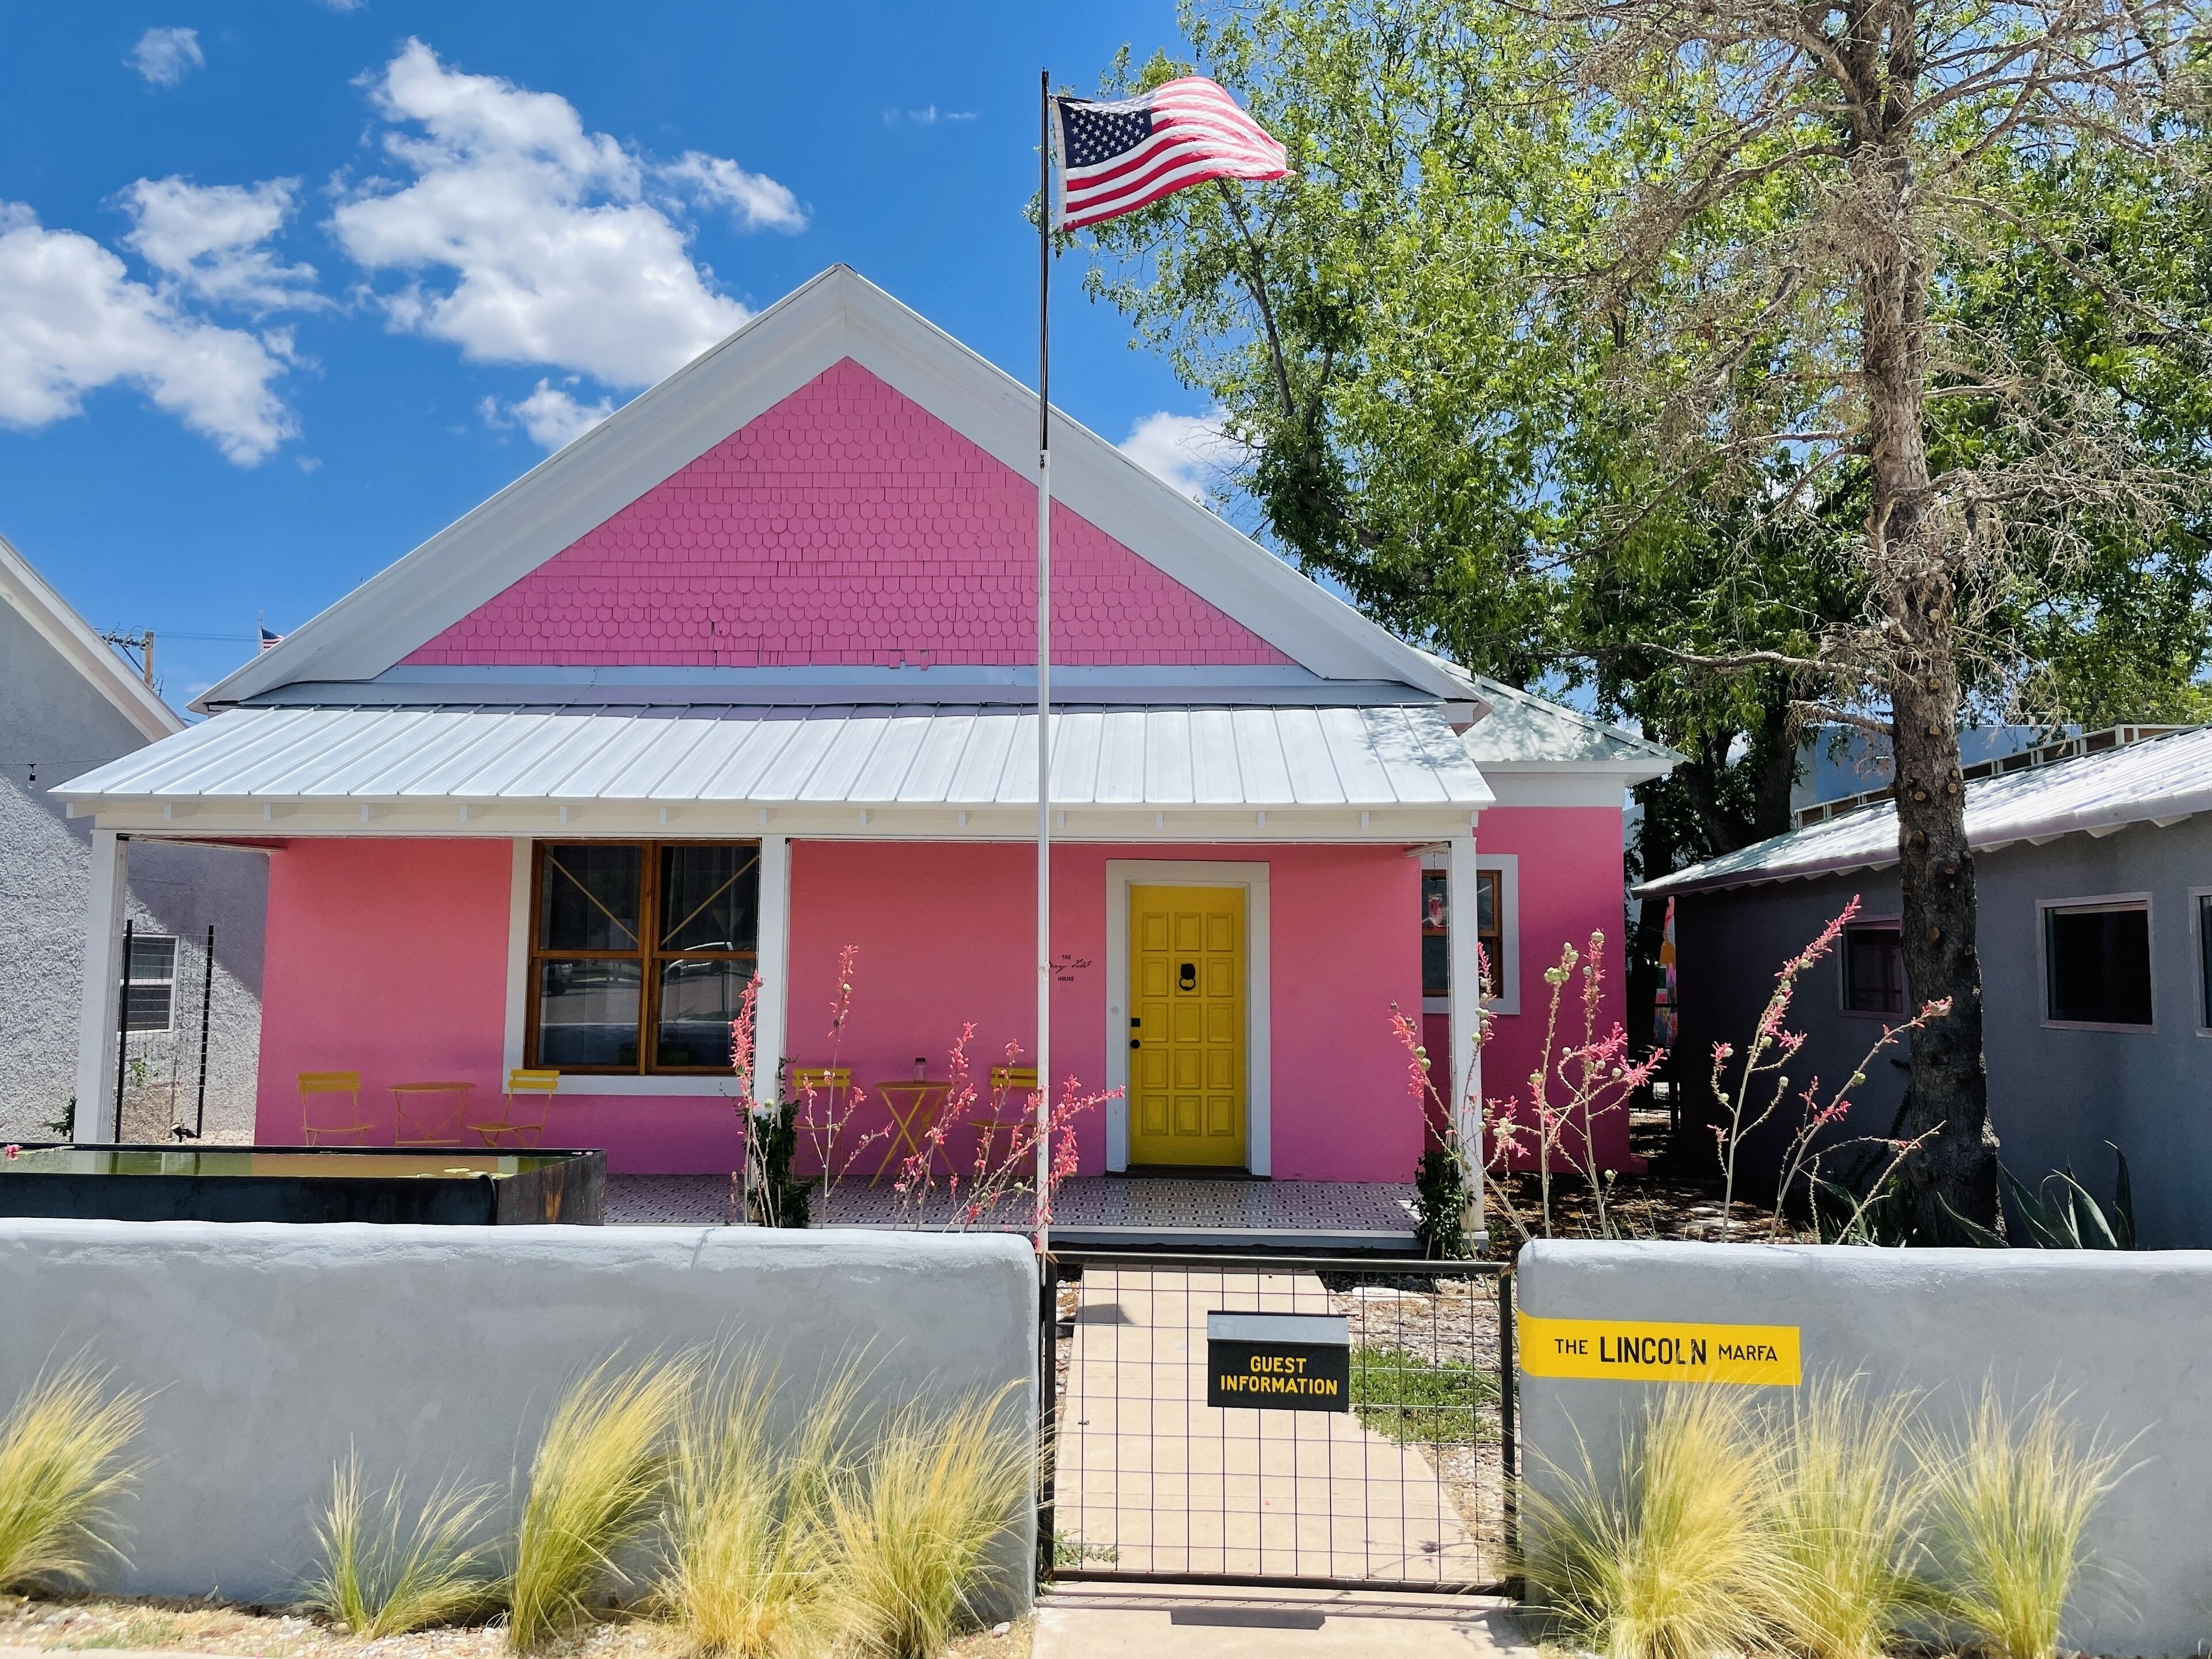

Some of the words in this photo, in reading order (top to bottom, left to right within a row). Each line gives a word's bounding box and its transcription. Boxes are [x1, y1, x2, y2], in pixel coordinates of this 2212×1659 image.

[1555, 1339, 1588, 1354] THE
[1600, 1336, 1707, 1365] LINCOLN
[1718, 1344, 1778, 1361] MARFA
[1250, 1356, 1306, 1373] GUEST
[1221, 1375, 1338, 1395] INFORMATION
